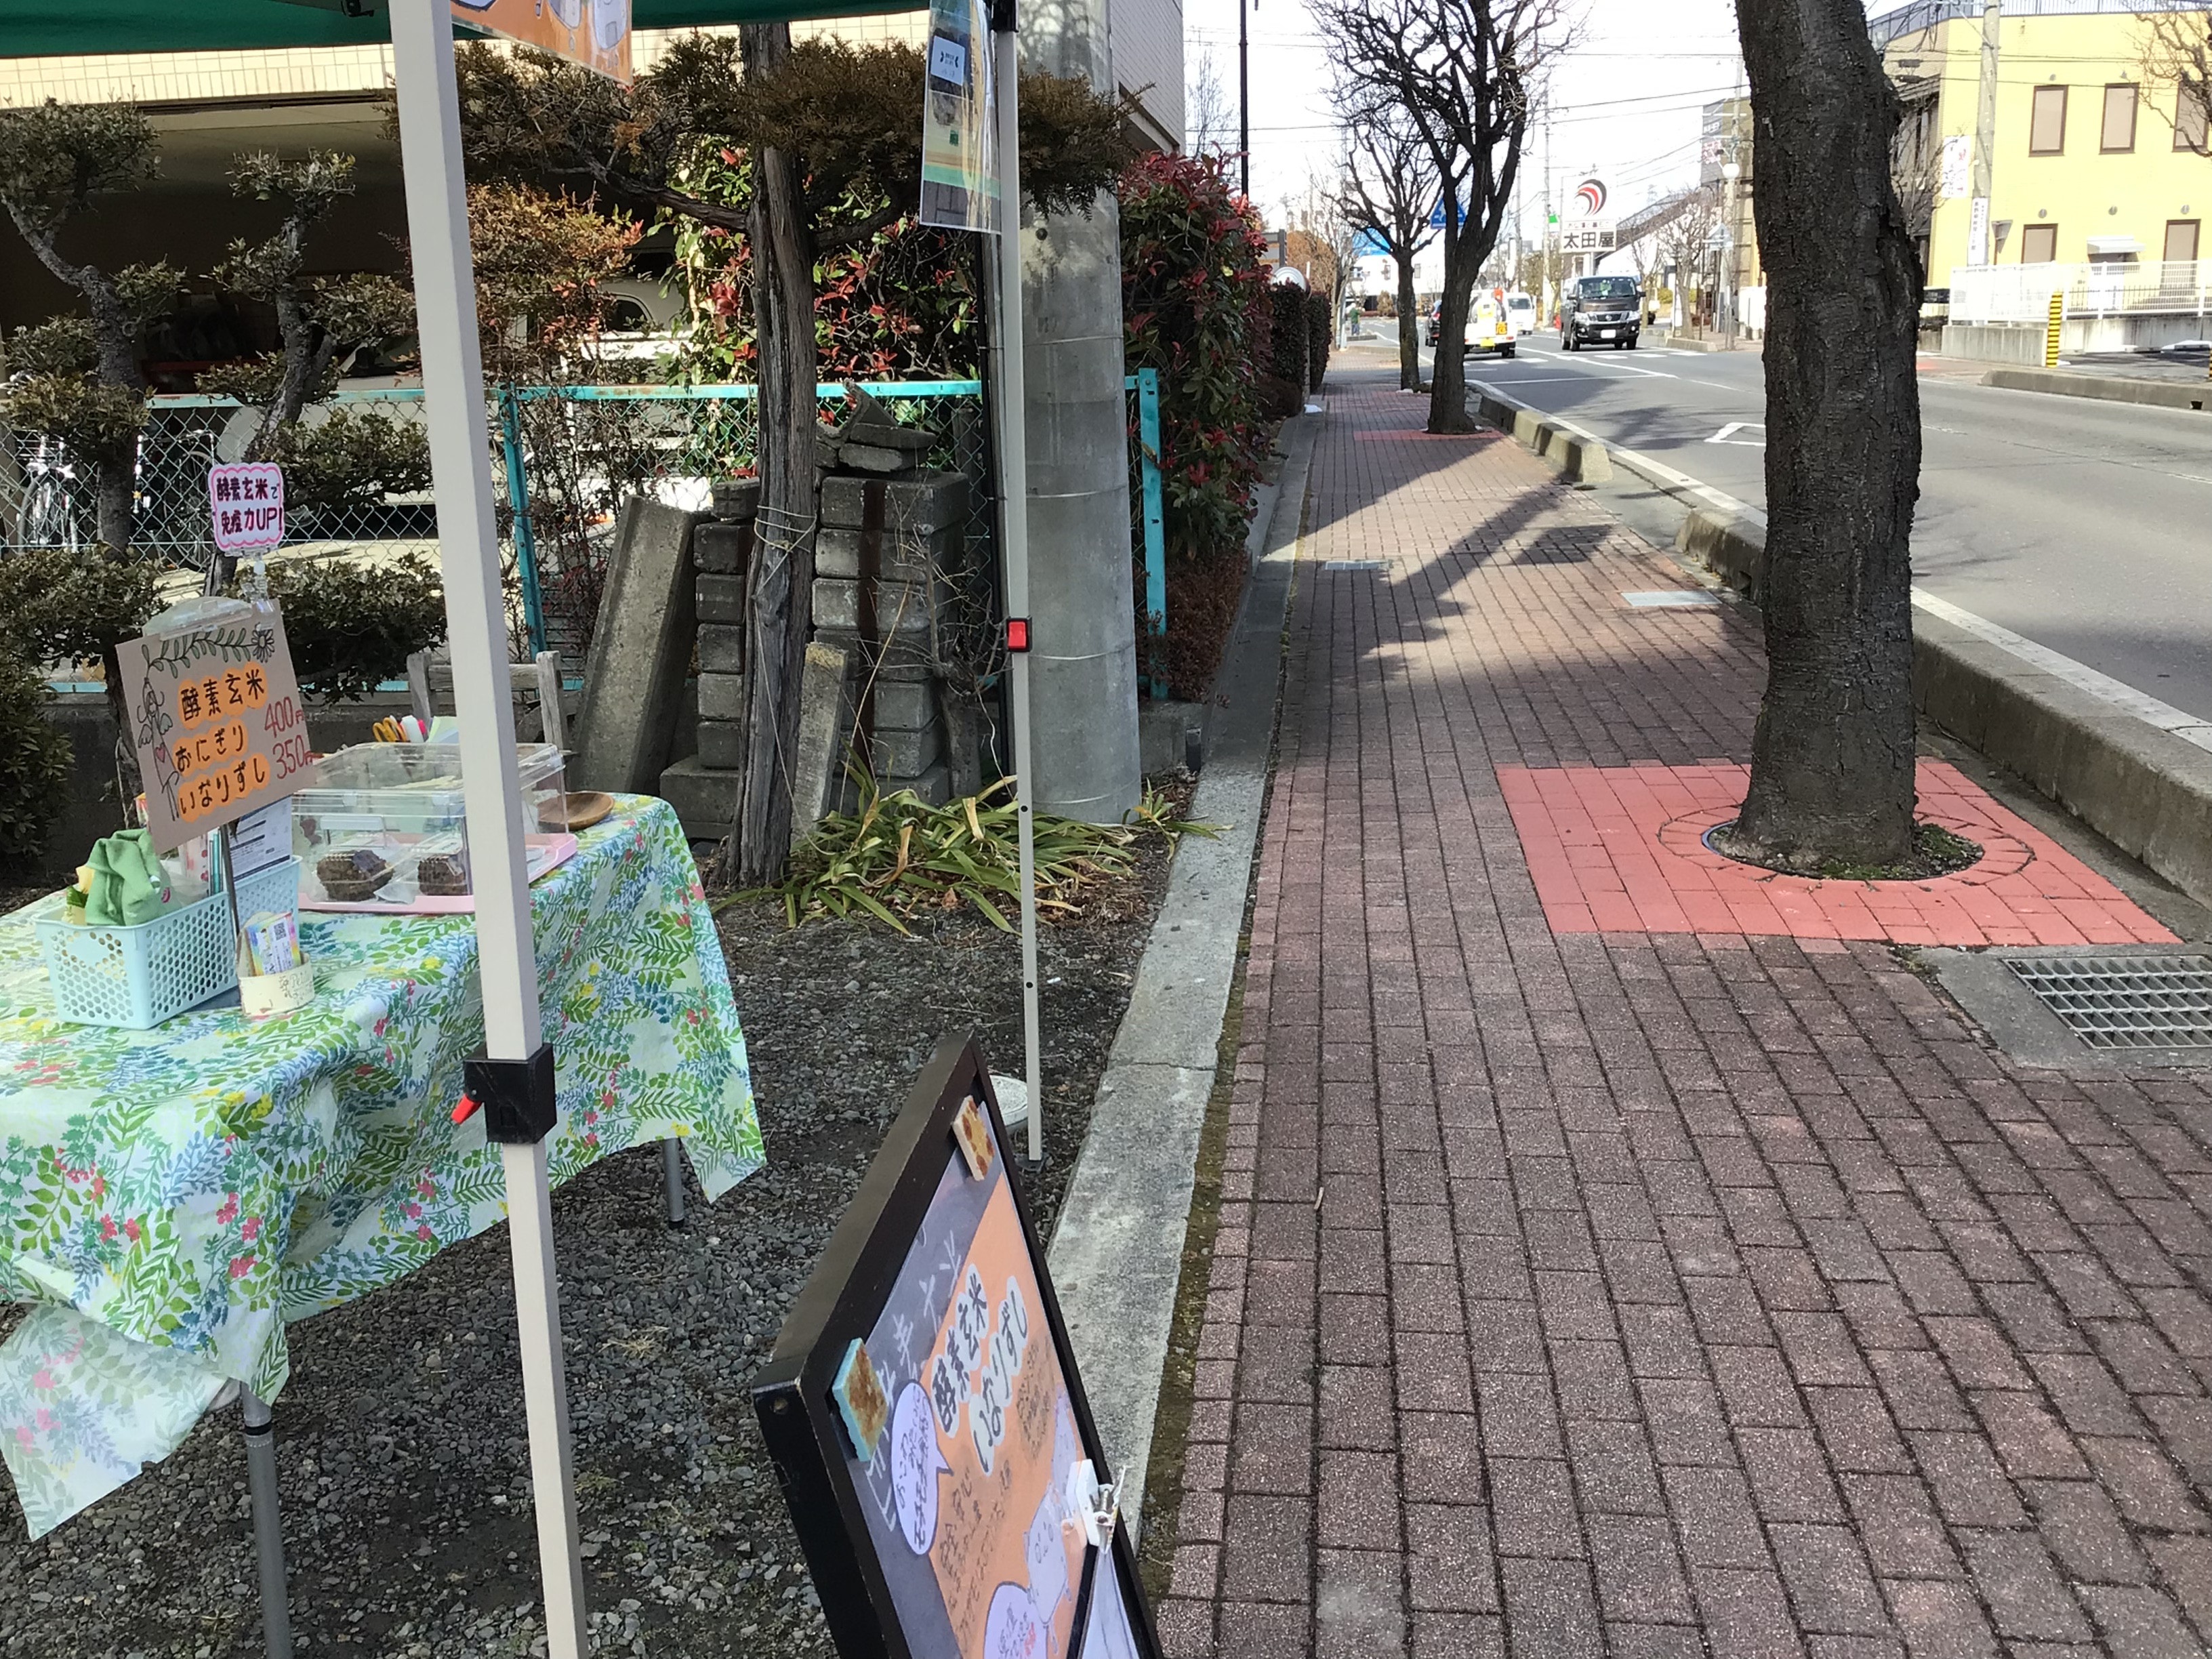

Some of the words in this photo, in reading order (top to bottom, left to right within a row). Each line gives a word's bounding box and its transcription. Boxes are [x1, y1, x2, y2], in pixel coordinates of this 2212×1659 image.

[1563, 232, 1614, 249] 太田屋
[216, 476, 280, 501] 酵素玄米で
[180, 669, 265, 721] 酵素玄米
[176, 724, 244, 772] おにぎり
[180, 758, 266, 814] いなりずし
[932, 1272, 987, 1433] 酵素玄米
[974, 1290, 1027, 1473] いなりずし
